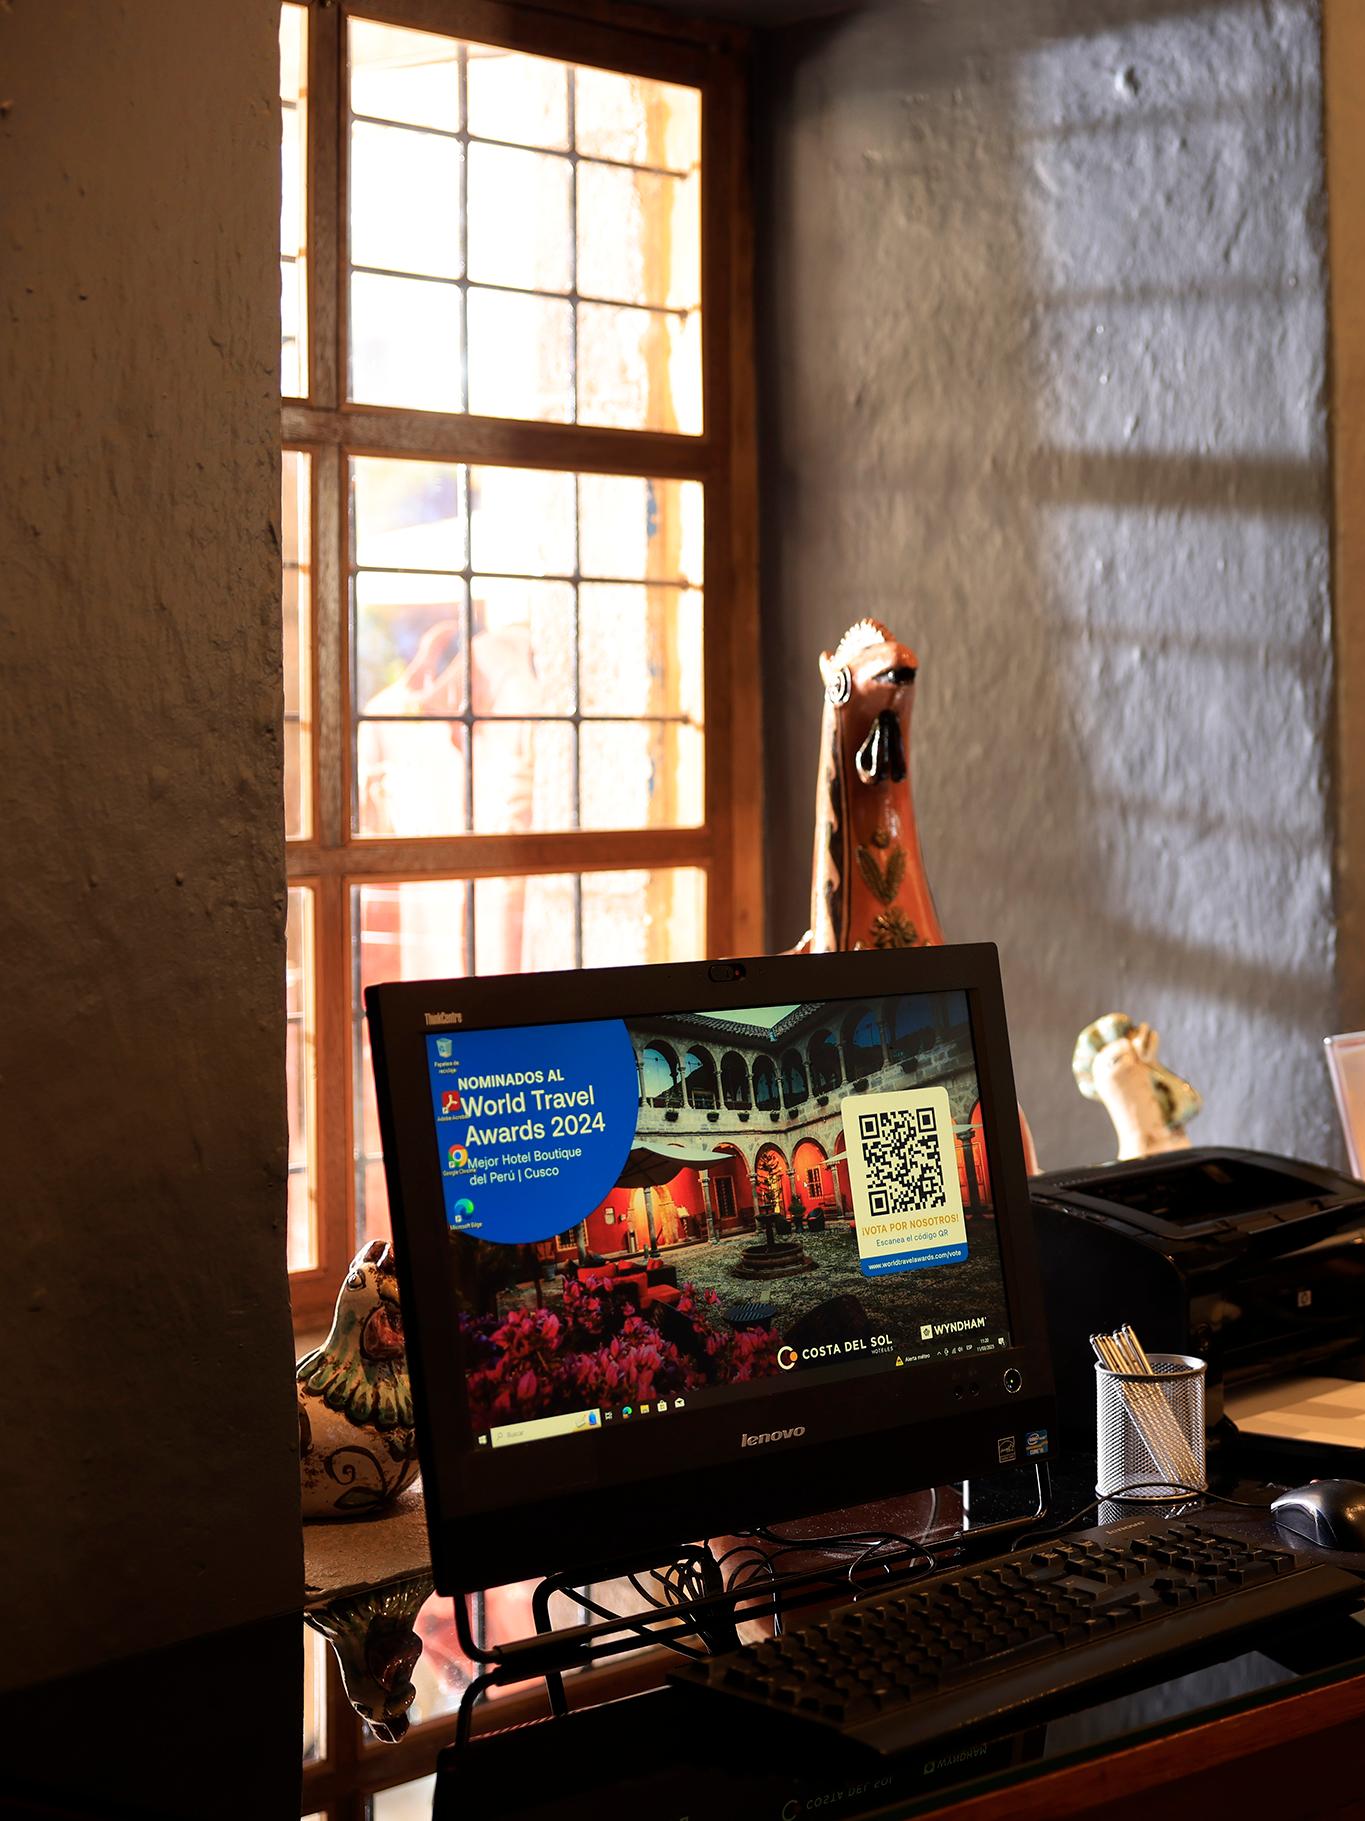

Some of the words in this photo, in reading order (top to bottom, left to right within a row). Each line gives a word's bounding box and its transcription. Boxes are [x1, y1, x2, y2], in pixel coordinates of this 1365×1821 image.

[458, 1070, 544, 1091] NOMINADOS
[547, 1069, 565, 1083] AL
[460, 1092, 526, 1118] World
[531, 1085, 595, 1110] Travel
[465, 1119, 546, 1147] Awards
[551, 1111, 606, 1137] 2024
[467, 1154, 499, 1171] Mejor
[502, 1153, 531, 1166] Hotel
[534, 1146, 582, 1162] Boutique
[469, 1172, 487, 1186] del
[489, 1168, 516, 1184] Perú
[524, 1166, 559, 1180] Cusco
[889, 1221, 908, 1232] POR
[909, 1214, 959, 1229] NOSOTROS!
[876, 1237, 905, 1247] Escanea
[906, 1234, 913, 1243] el
[914, 1231, 937, 1242] código
[938, 1229, 949, 1238] QR
[868, 1250, 962, 1270] www.worldtravelawards.com/vote
[934, 1317, 985, 1336] WYNDHAM
[802, 1343, 841, 1360] COSTA
[844, 1339, 867, 1352] DEL
[870, 1334, 893, 1348] SOL
[871, 1346, 894, 1355] HOTELES
[741, 1425, 806, 1447] lenovo
